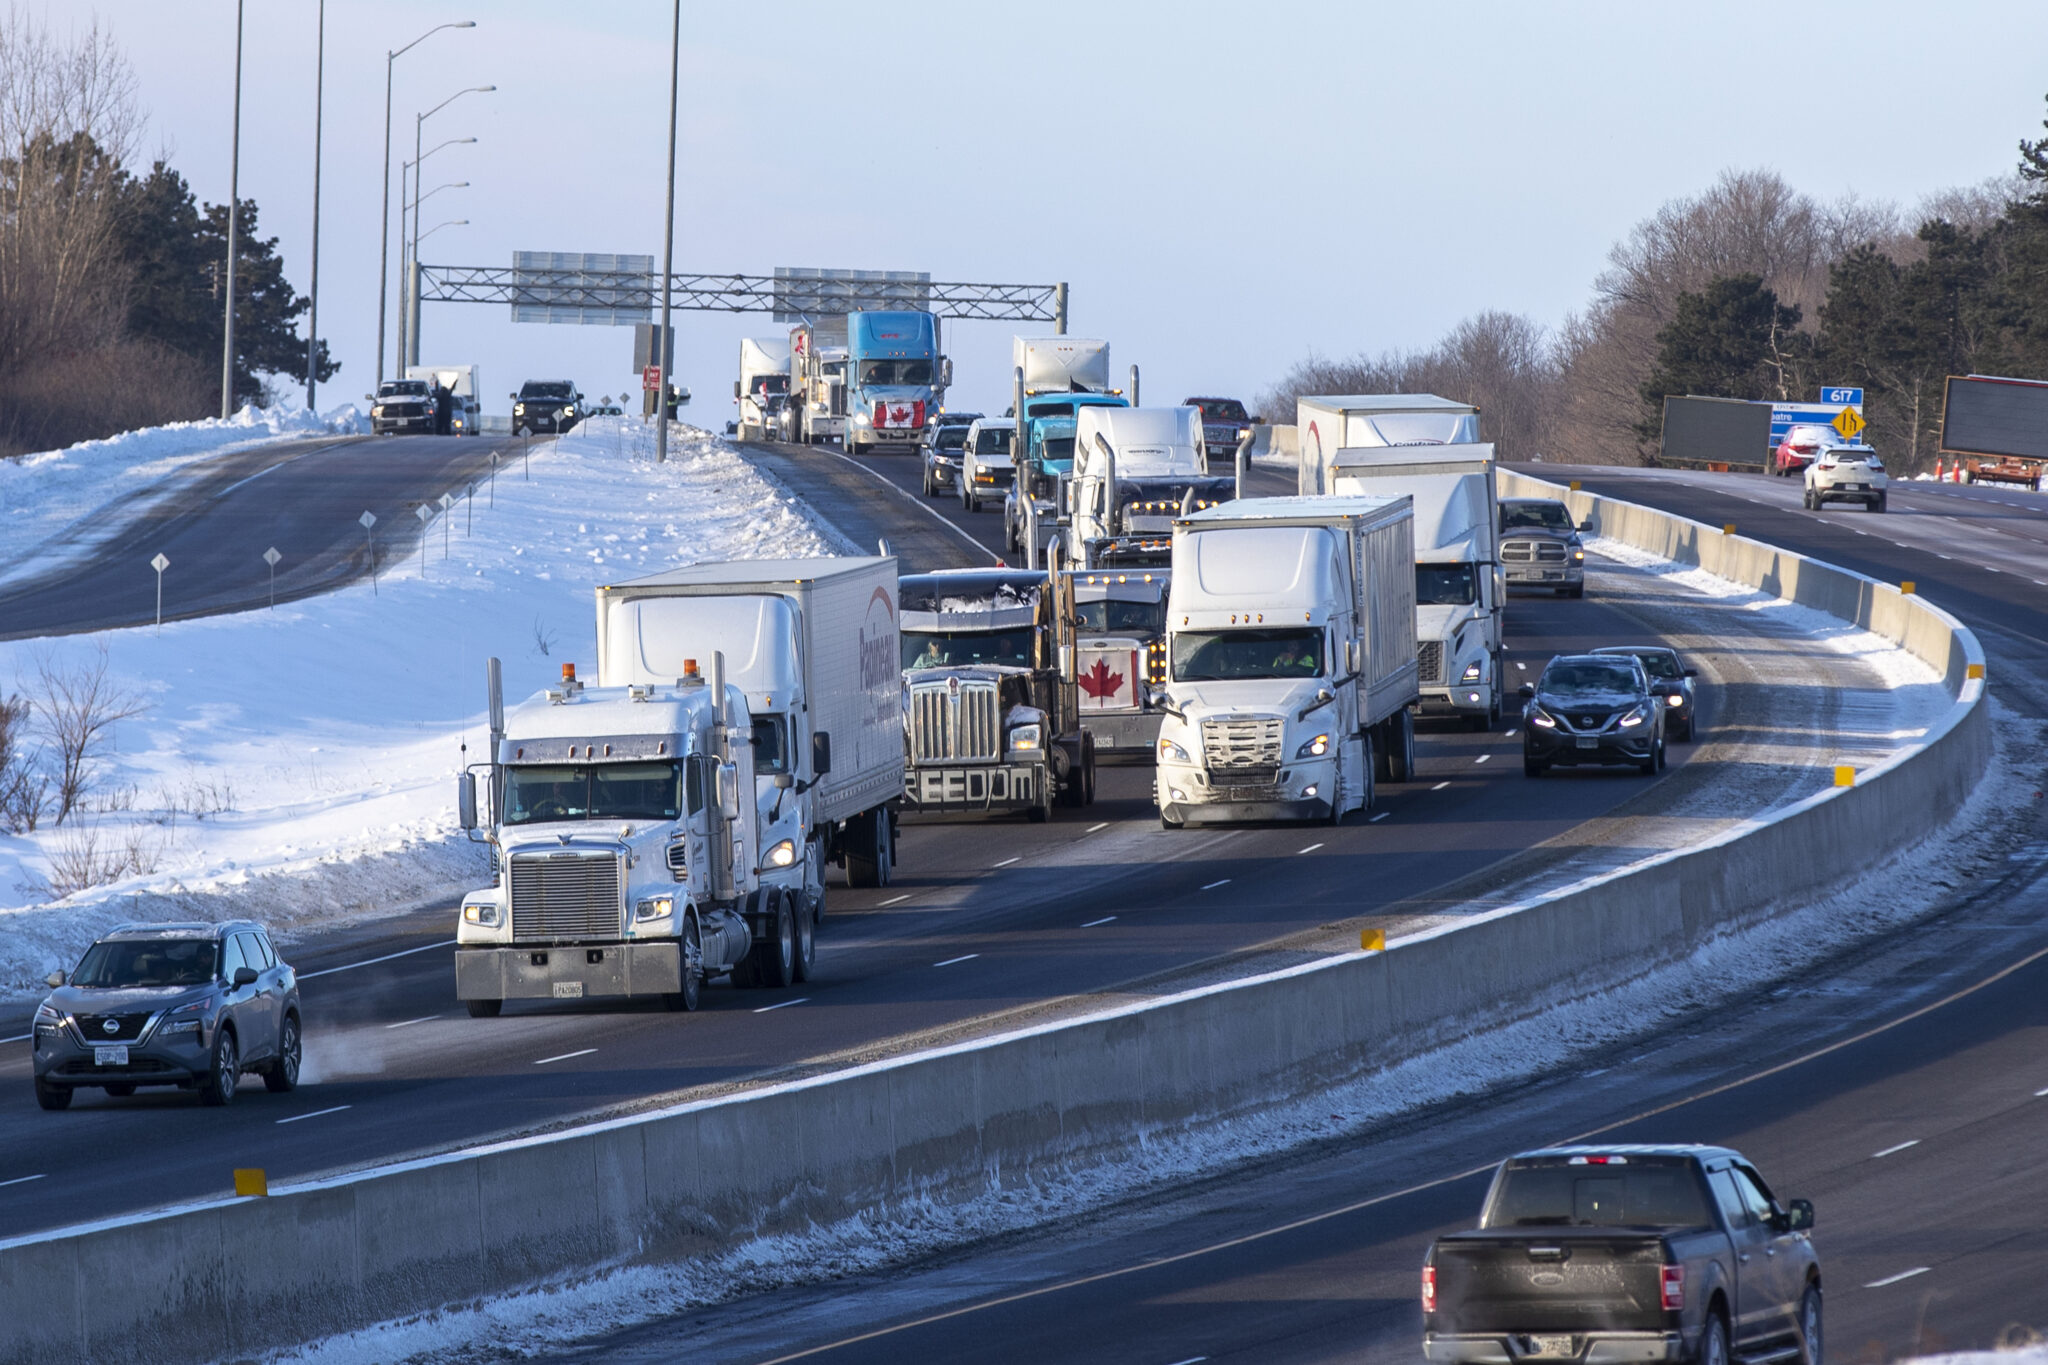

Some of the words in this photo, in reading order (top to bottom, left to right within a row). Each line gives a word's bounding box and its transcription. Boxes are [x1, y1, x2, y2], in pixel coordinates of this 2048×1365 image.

[1830, 390, 1853, 402] 617
[859, 622, 894, 702] Papineau
[904, 768, 1033, 803] REEDOM
